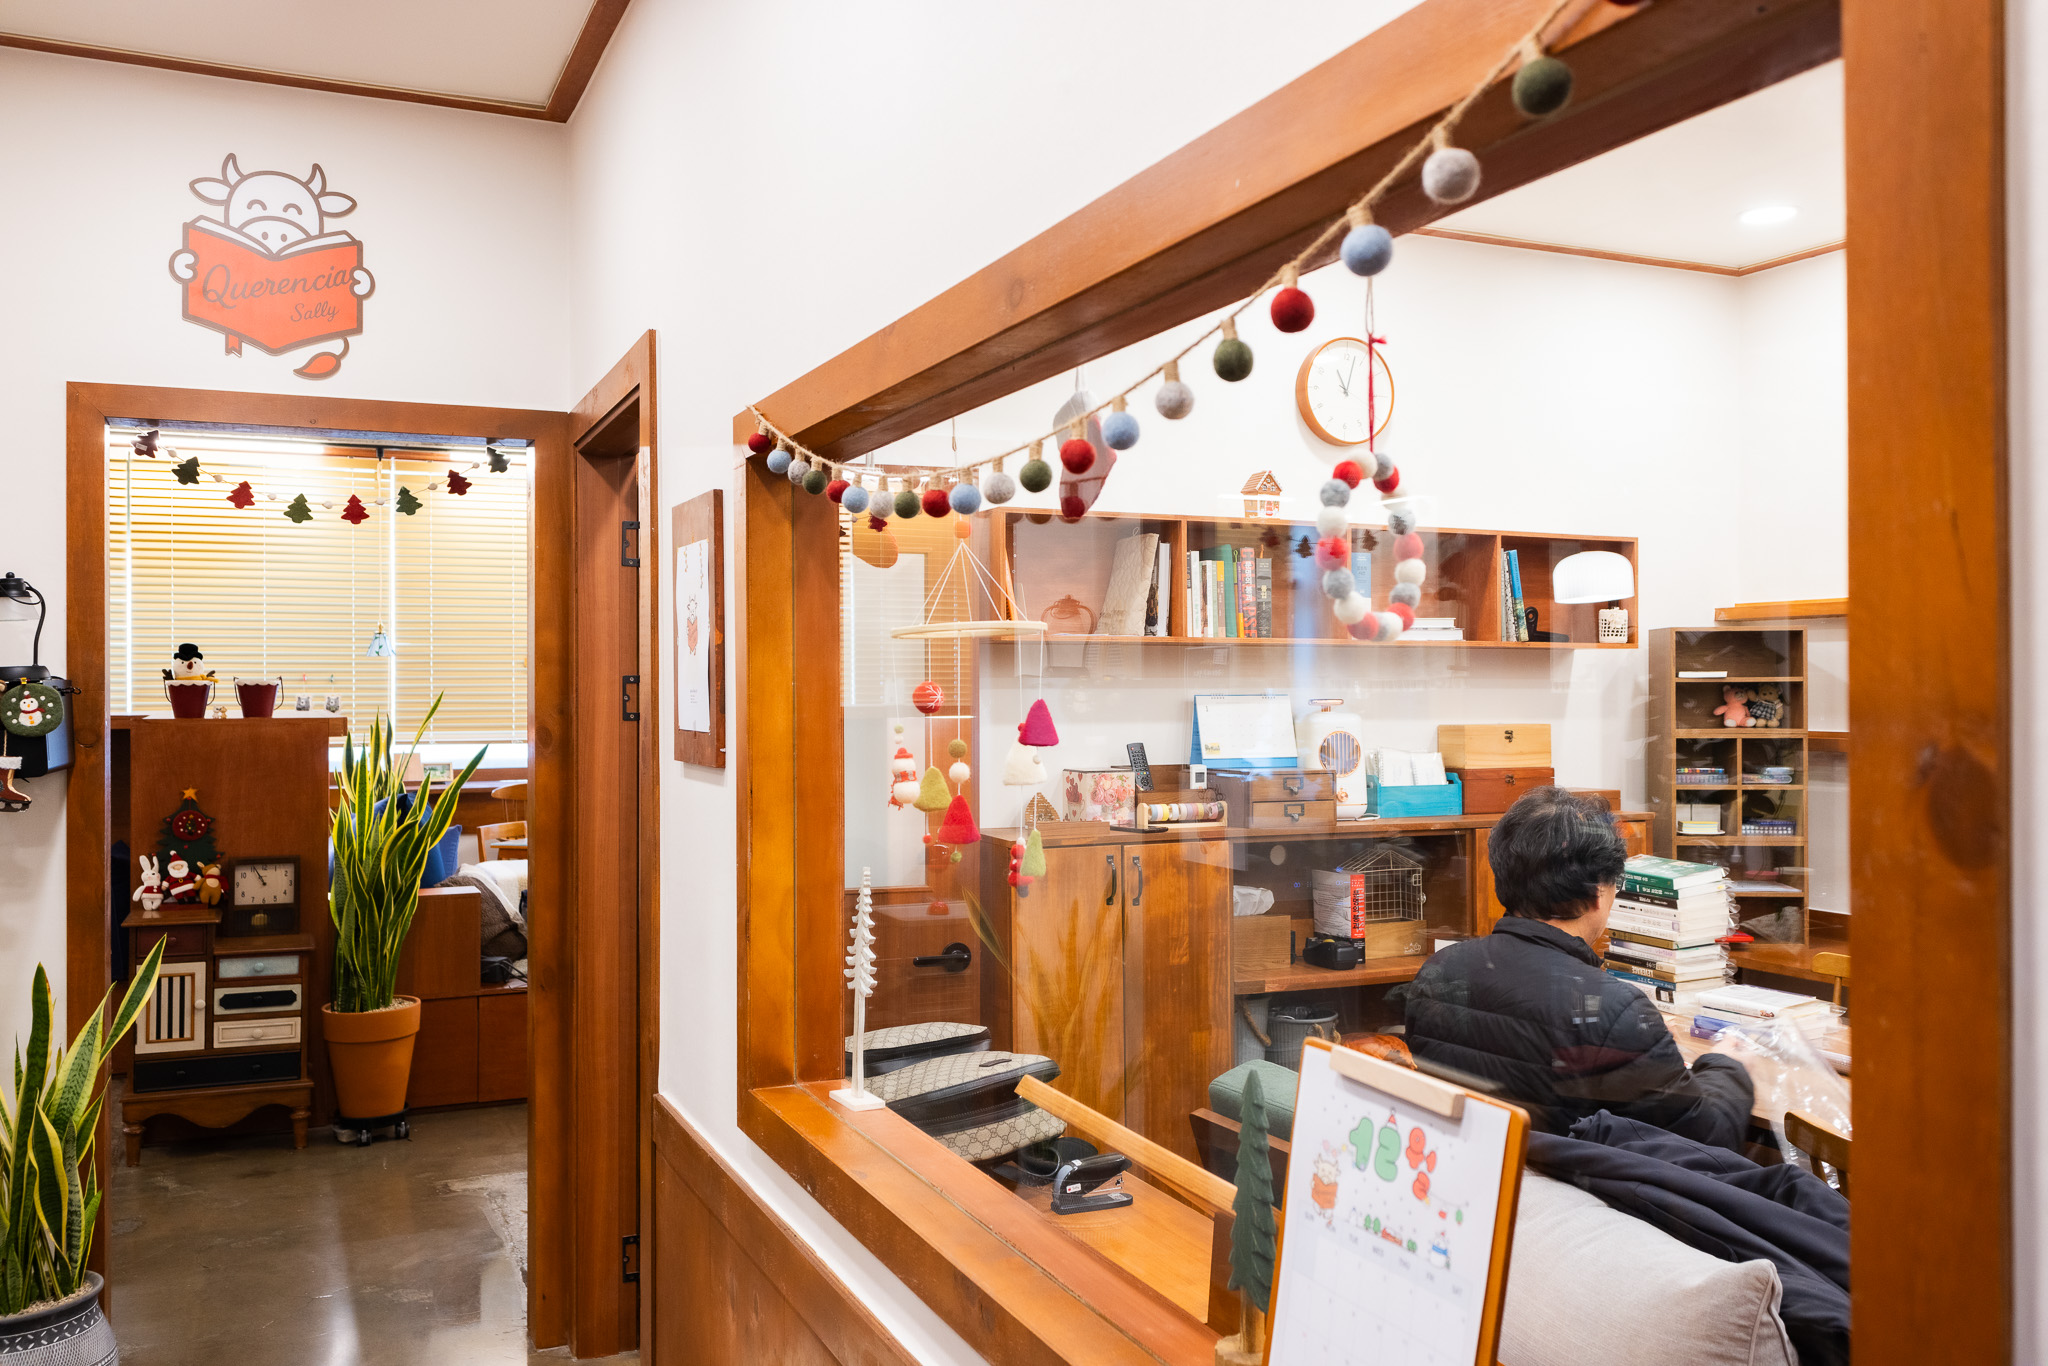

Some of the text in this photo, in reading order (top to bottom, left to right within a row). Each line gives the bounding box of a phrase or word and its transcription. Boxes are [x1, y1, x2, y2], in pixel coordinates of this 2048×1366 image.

[202, 264, 351, 310] Querencia
[290, 302, 341, 323] Sally
[1241, 548, 1257, 638] COLLAPSE
[1356, 888, 1365, 932] COLLAPSE
